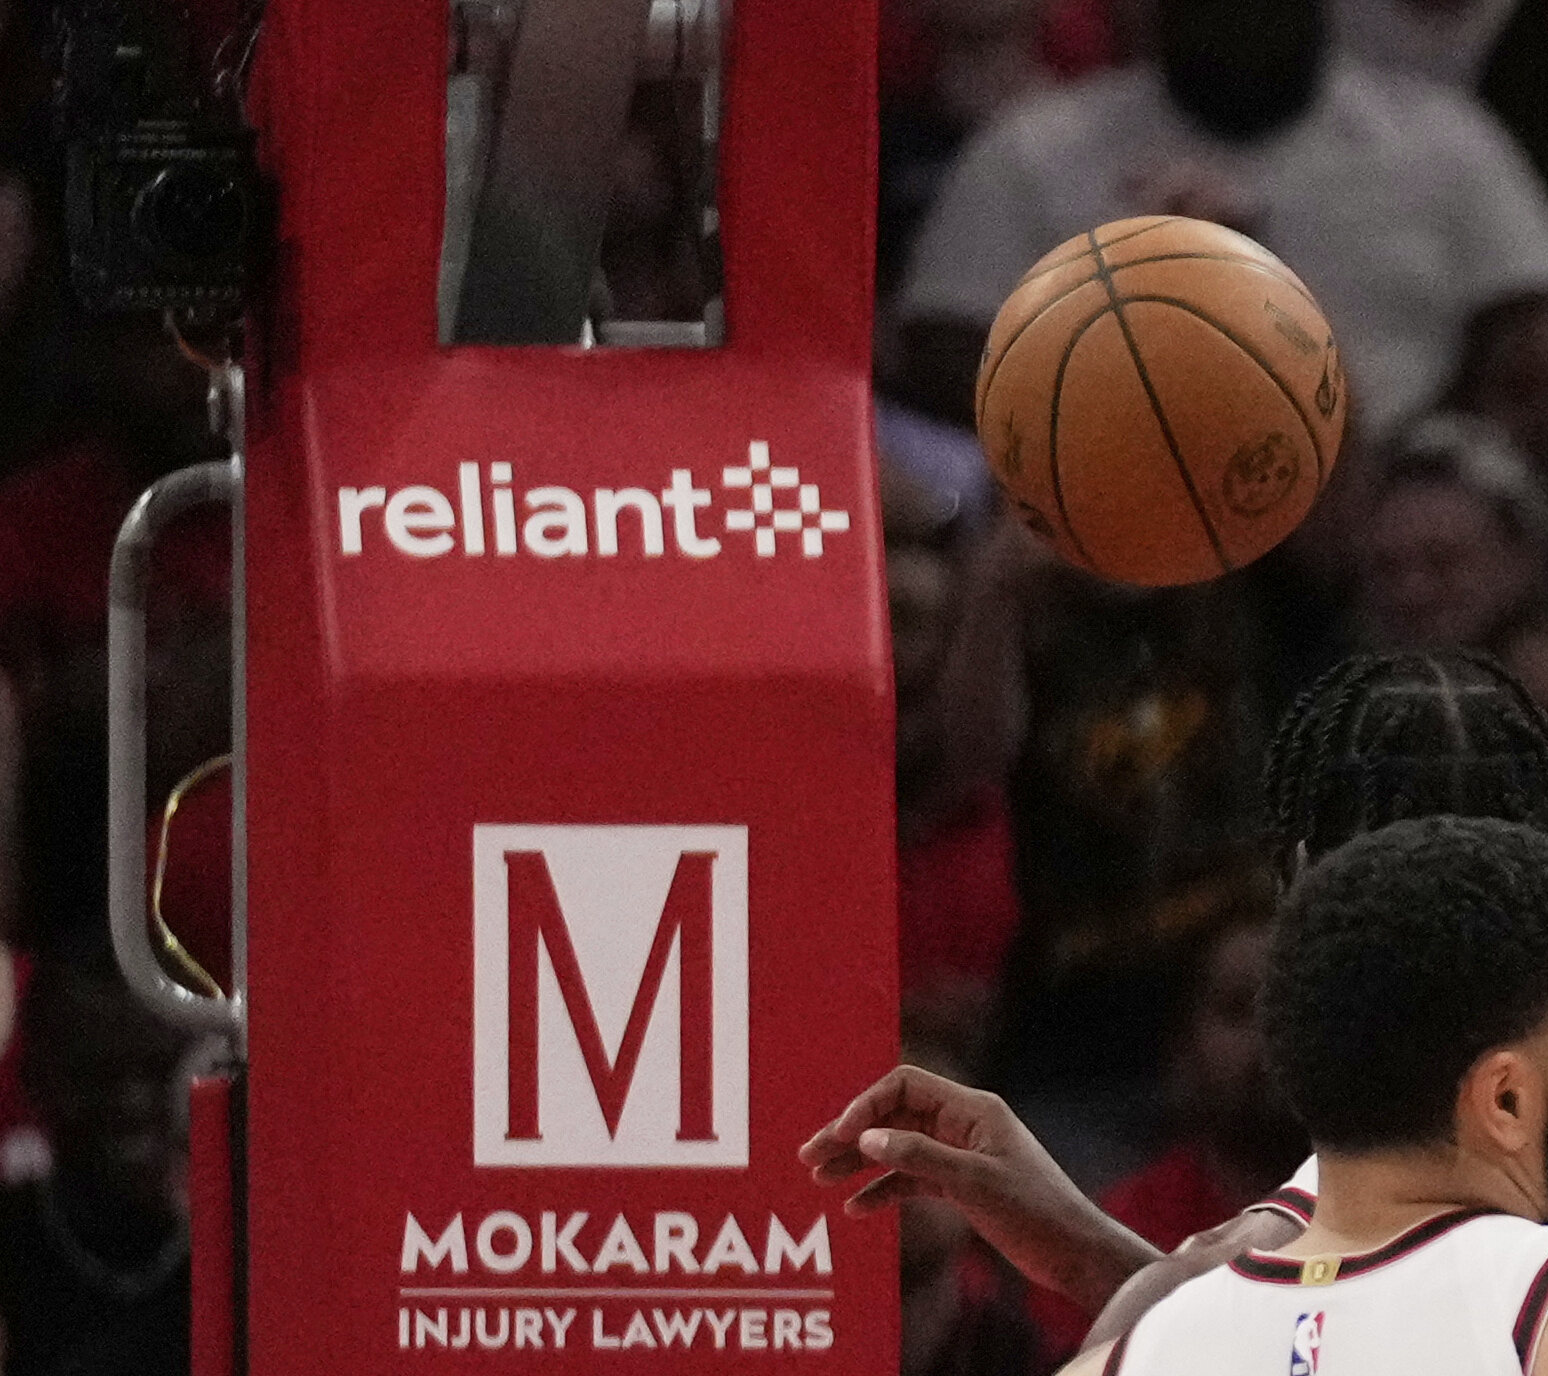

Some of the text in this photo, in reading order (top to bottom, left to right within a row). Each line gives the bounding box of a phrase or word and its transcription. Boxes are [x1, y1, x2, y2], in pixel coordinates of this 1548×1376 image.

[337, 461, 721, 558] reliant
[503, 849, 718, 1142] M
[401, 1211, 833, 1275] MOKARAM
[400, 1308, 834, 1348] INJURY LAWYERS
